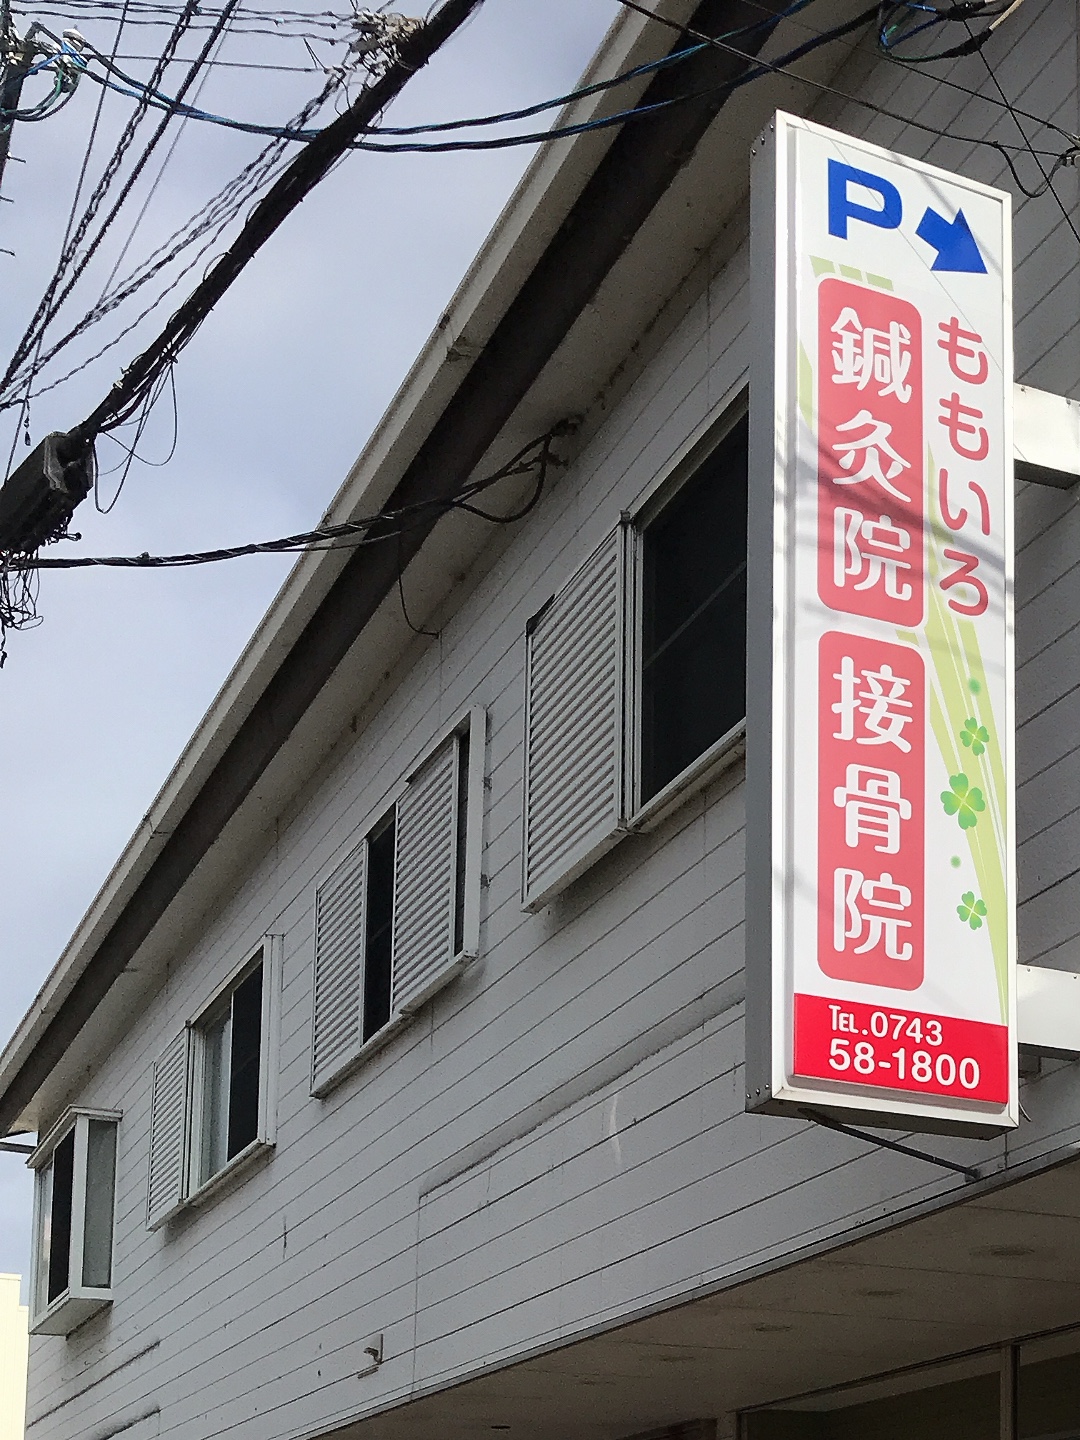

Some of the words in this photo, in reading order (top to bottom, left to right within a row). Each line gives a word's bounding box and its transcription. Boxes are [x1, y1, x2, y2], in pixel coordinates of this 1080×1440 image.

[827, 158, 902, 240] P
[830, 306, 914, 602] 鍼灸院
[937, 316, 990, 617] ももいろ
[832, 655, 914, 964] 接骨院
[828, 1039, 981, 1090] 58-1800
